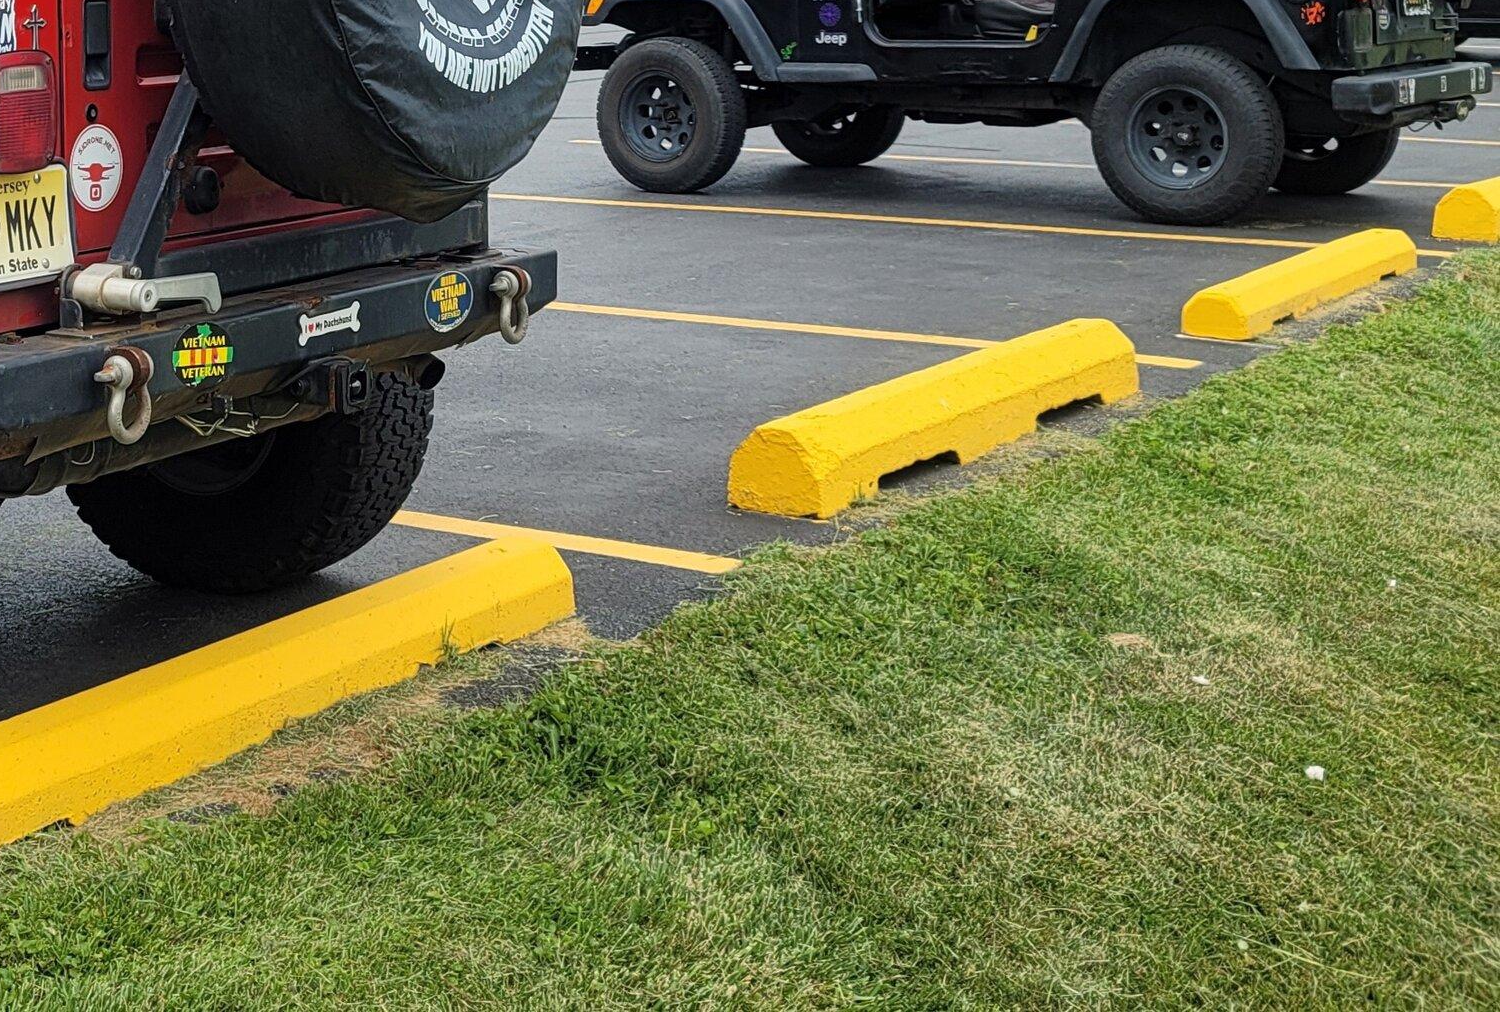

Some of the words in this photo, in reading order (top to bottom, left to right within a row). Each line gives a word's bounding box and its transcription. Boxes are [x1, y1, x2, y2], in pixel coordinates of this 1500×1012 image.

[815, 32, 847, 46] Jeep
[418, 21, 447, 72] YOU
[444, 48, 473, 90] ARE
[470, 58, 499, 93] NOT
[5, 195, 56, 253] MKY
[8, 256, 39, 272] State
[431, 282, 467, 303] VIETNAM
[440, 298, 459, 313] WAR
[182, 335, 226, 348] VIETNAM
[181, 365, 225, 379] VETERAN
